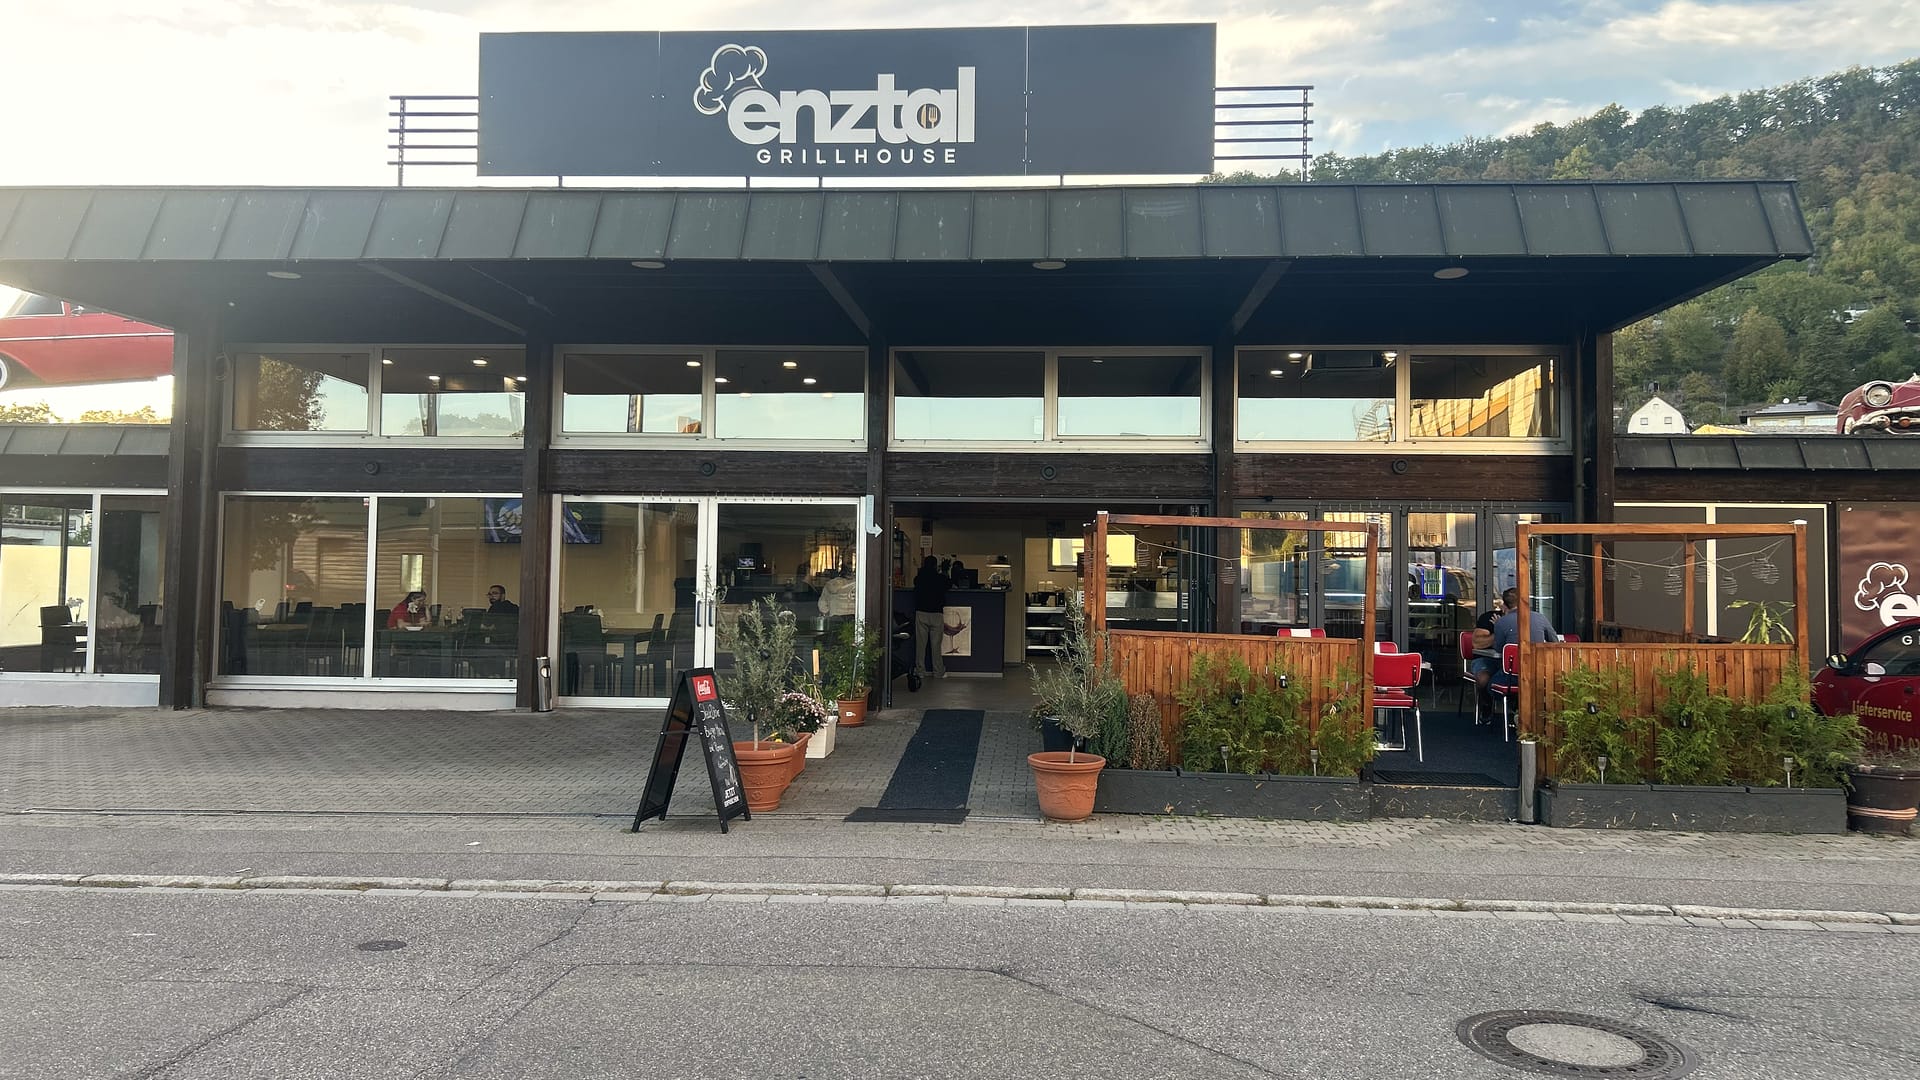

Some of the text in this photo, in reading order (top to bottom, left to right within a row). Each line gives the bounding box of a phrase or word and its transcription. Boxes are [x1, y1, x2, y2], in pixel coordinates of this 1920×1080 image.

[728, 66, 976, 145] enztal
[756, 149, 956, 164] GRILLHOUSE
[1880, 593, 1920, 627] e
[1852, 700, 1912, 722] Lieferservice
